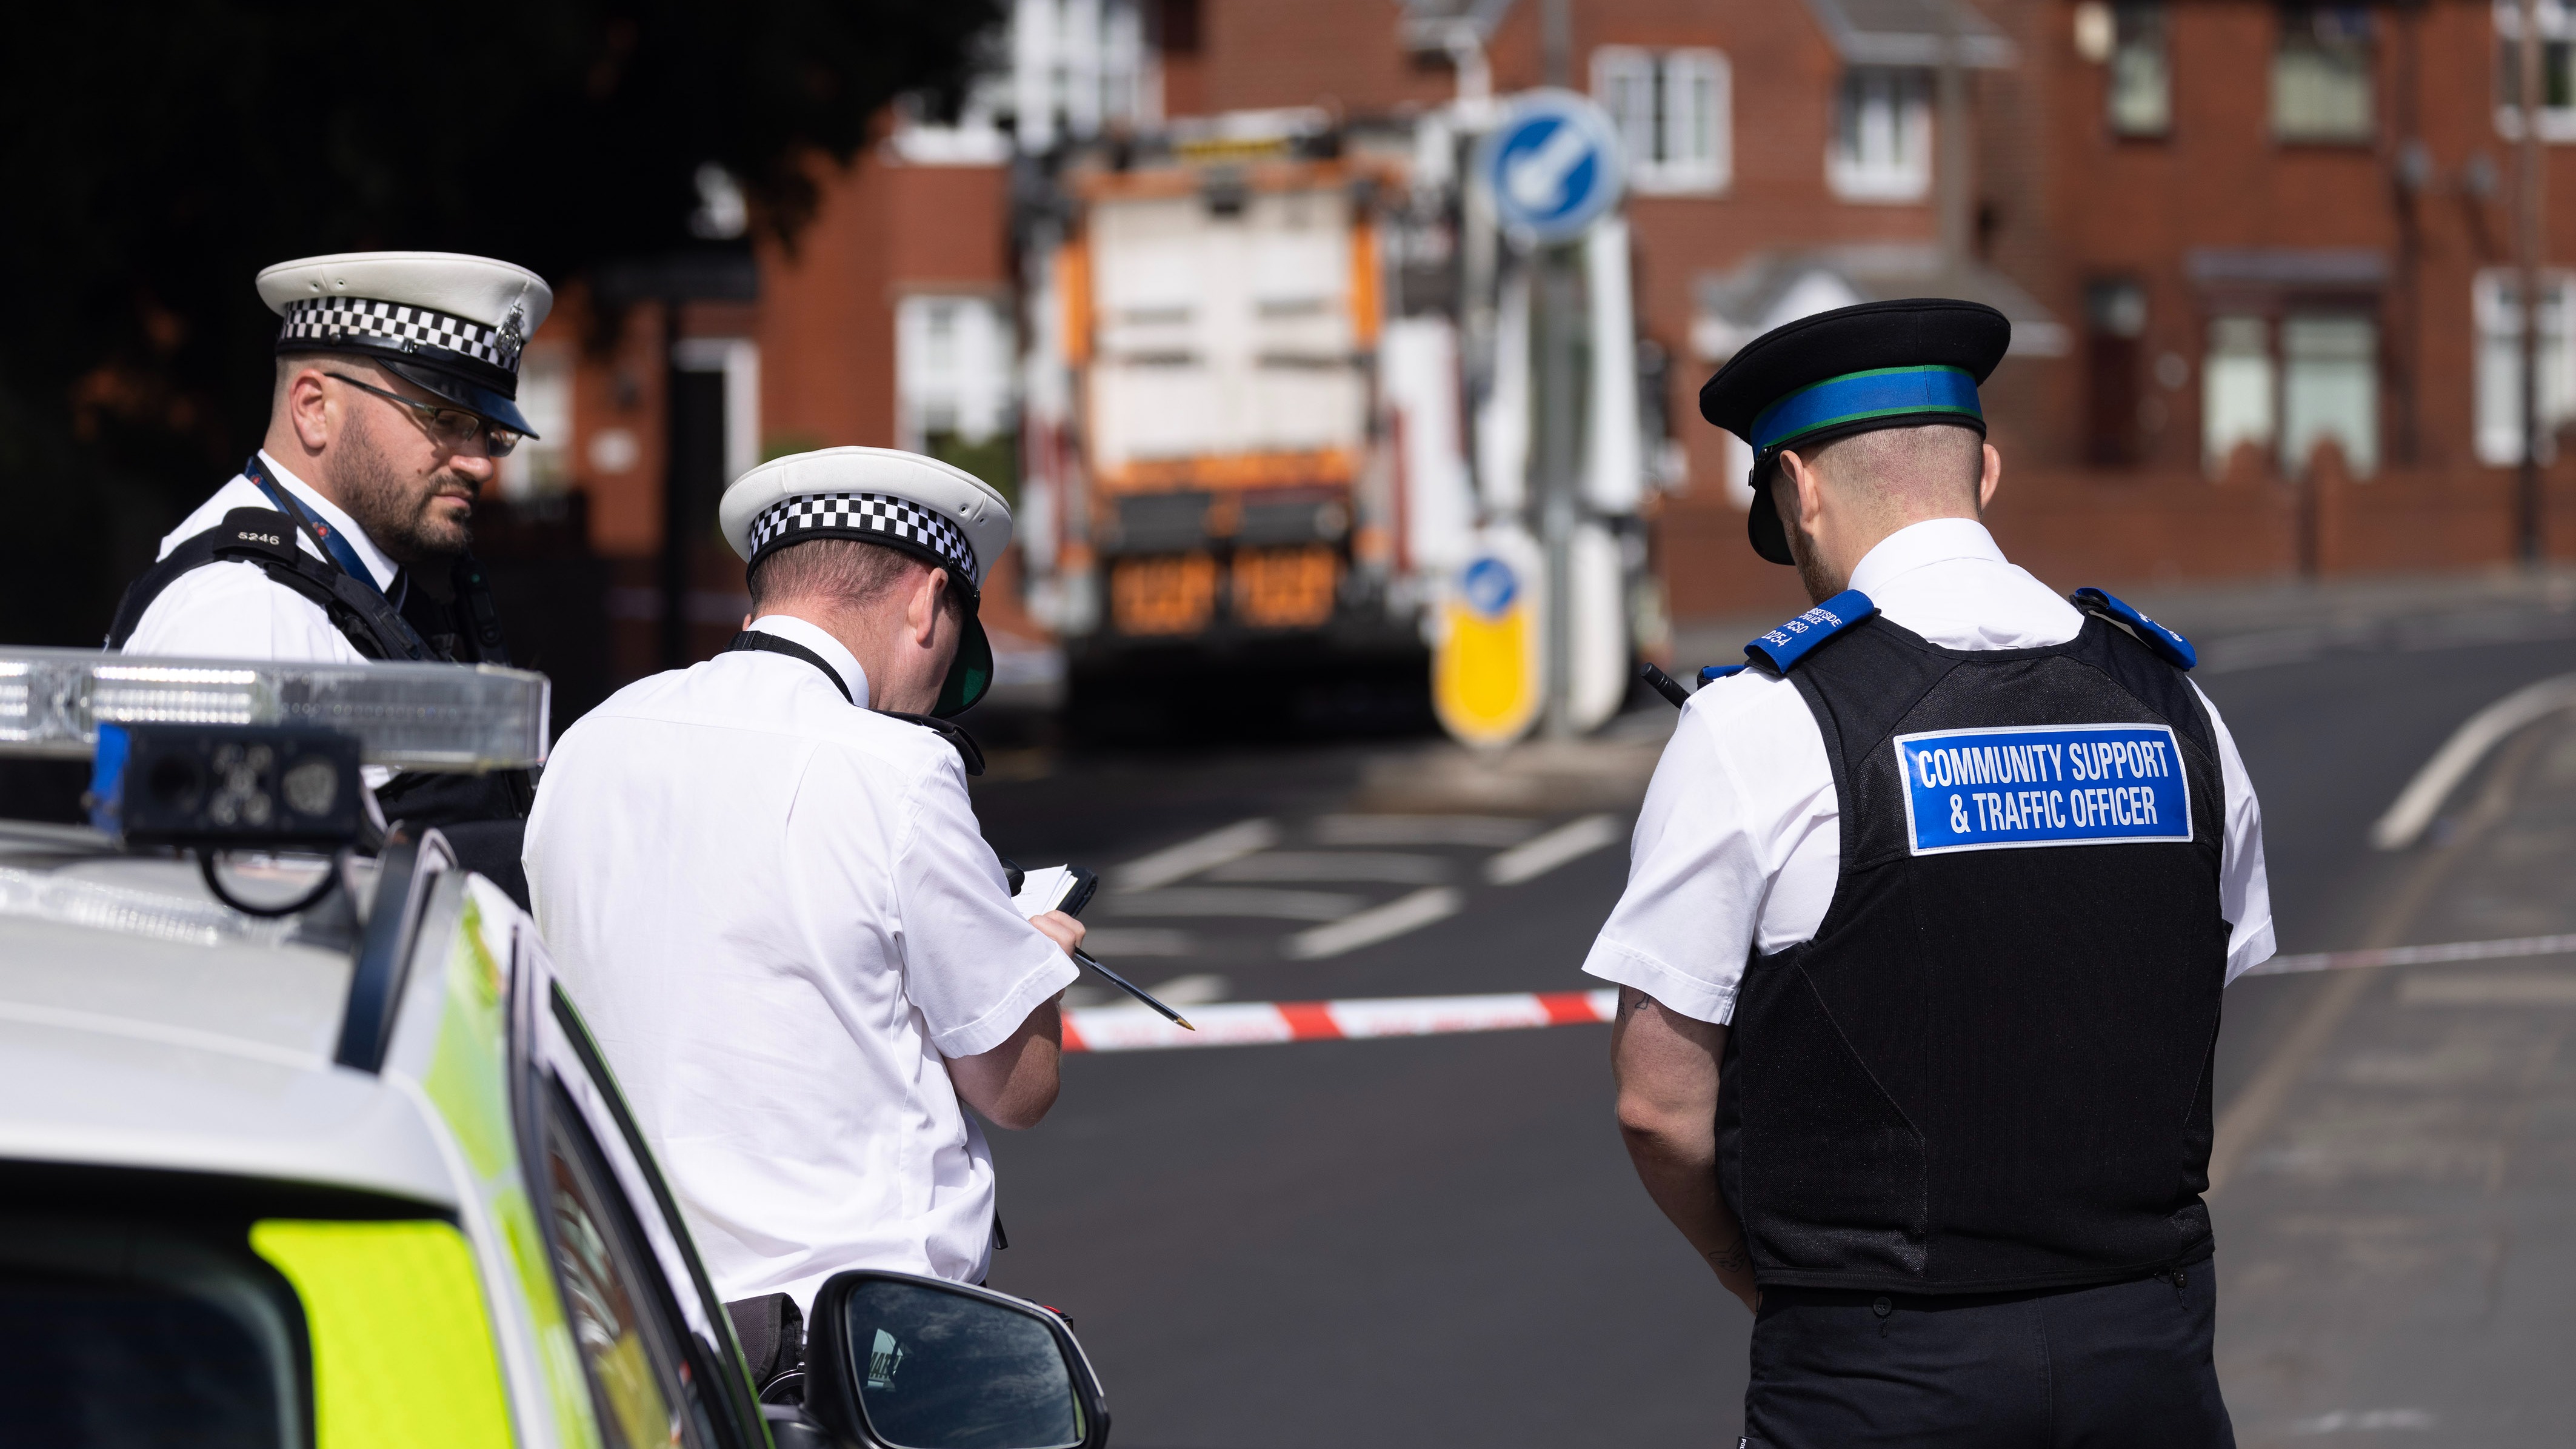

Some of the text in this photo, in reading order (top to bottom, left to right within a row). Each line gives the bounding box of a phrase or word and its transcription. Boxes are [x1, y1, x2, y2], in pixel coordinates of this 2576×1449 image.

[238, 532, 280, 546] 5246
[1783, 620, 1809, 634] PCSO
[1807, 607, 1843, 627] RSEYSIDE
[1918, 741, 2169, 788] COMMUNITY SUPPORT
[1949, 786, 2158, 834] & TRAFFIC OFFICER
